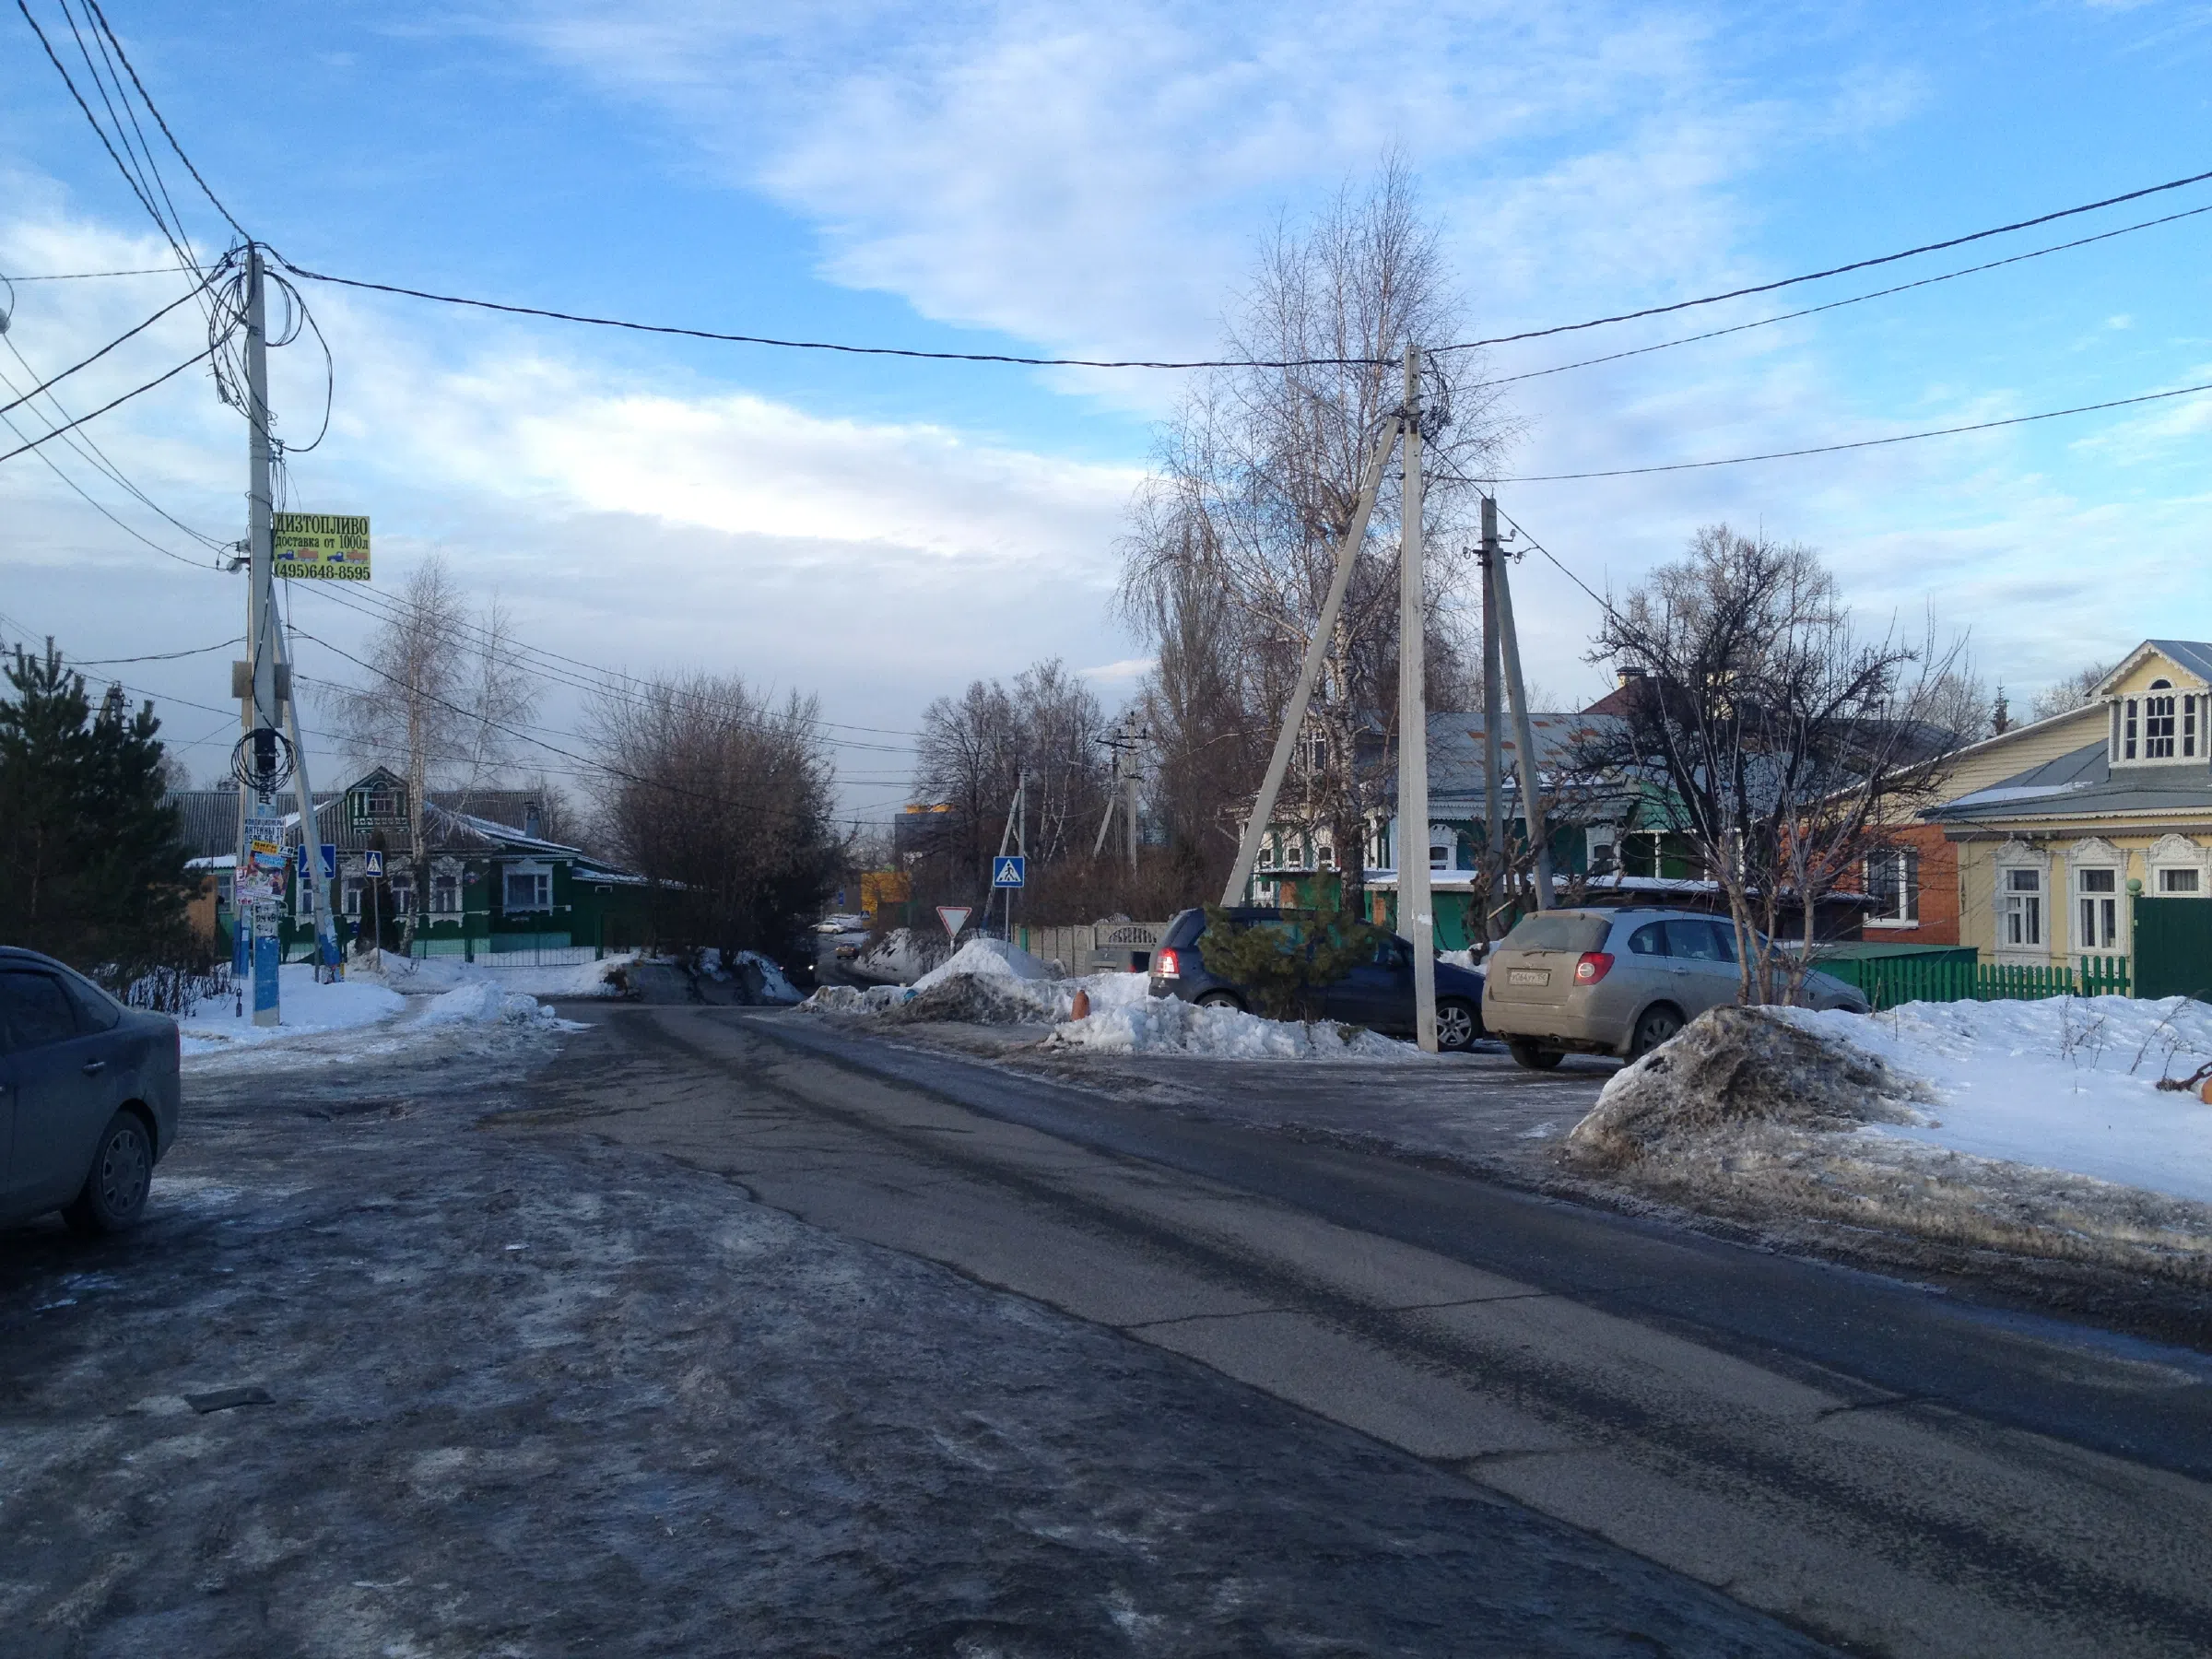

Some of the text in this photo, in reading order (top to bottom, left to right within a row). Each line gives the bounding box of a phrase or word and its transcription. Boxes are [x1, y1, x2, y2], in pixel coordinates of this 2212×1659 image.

[276, 514, 368, 535] ДИЗТОПЛИВО
[276, 535, 369, 549] доставка от 1000л
[275, 562, 371, 580] (495)648-8595
[244, 826, 284, 836] АНТЕННЫ ТВ
